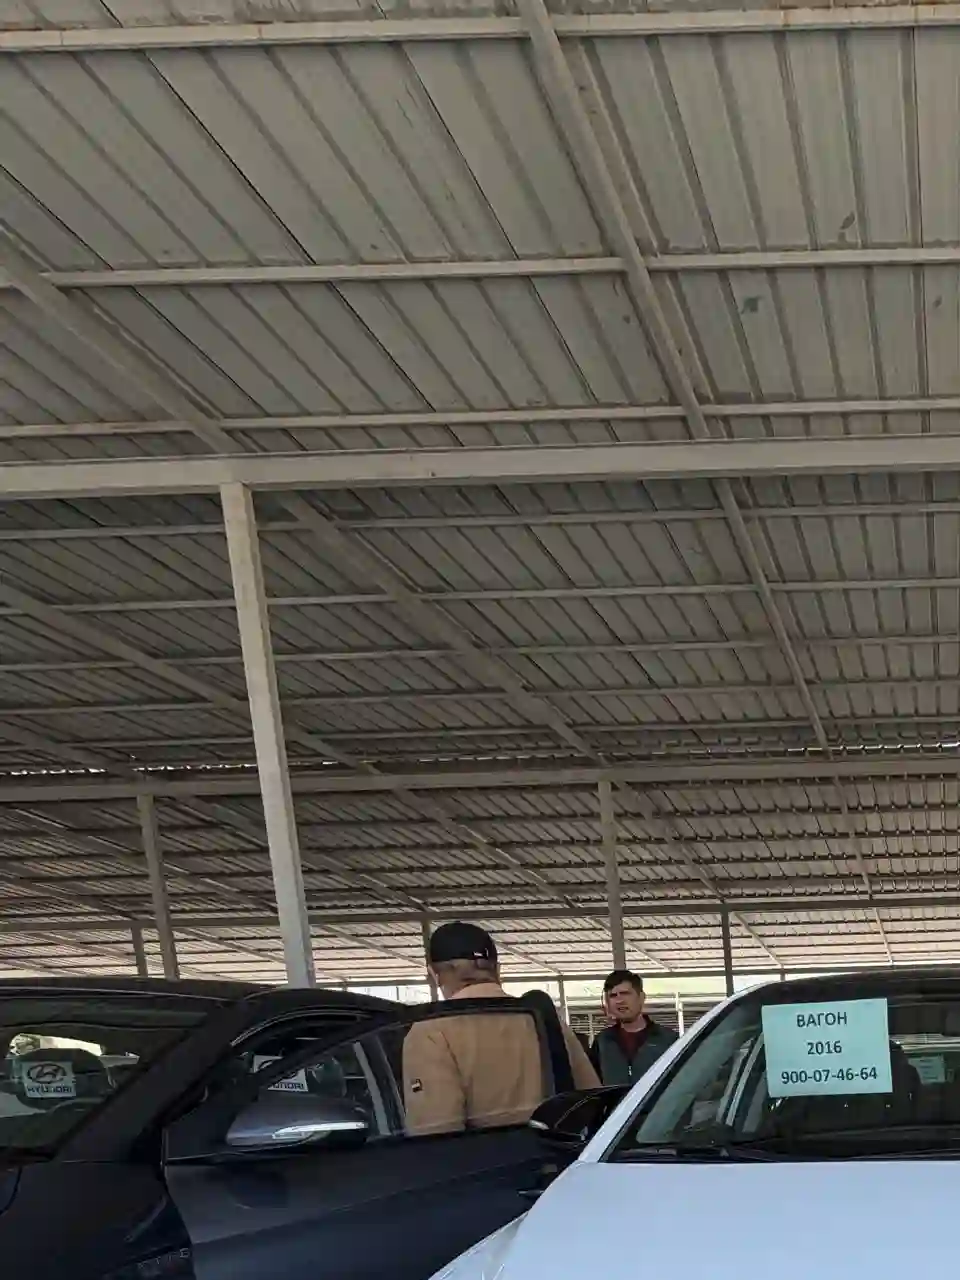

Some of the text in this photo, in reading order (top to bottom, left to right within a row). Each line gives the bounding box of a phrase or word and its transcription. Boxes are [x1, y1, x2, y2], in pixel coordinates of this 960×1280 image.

[796, 1011, 848, 1028] ВАГОН
[807, 1040, 842, 1055] 2016
[781, 1066, 878, 1085] 900-07-46-64
